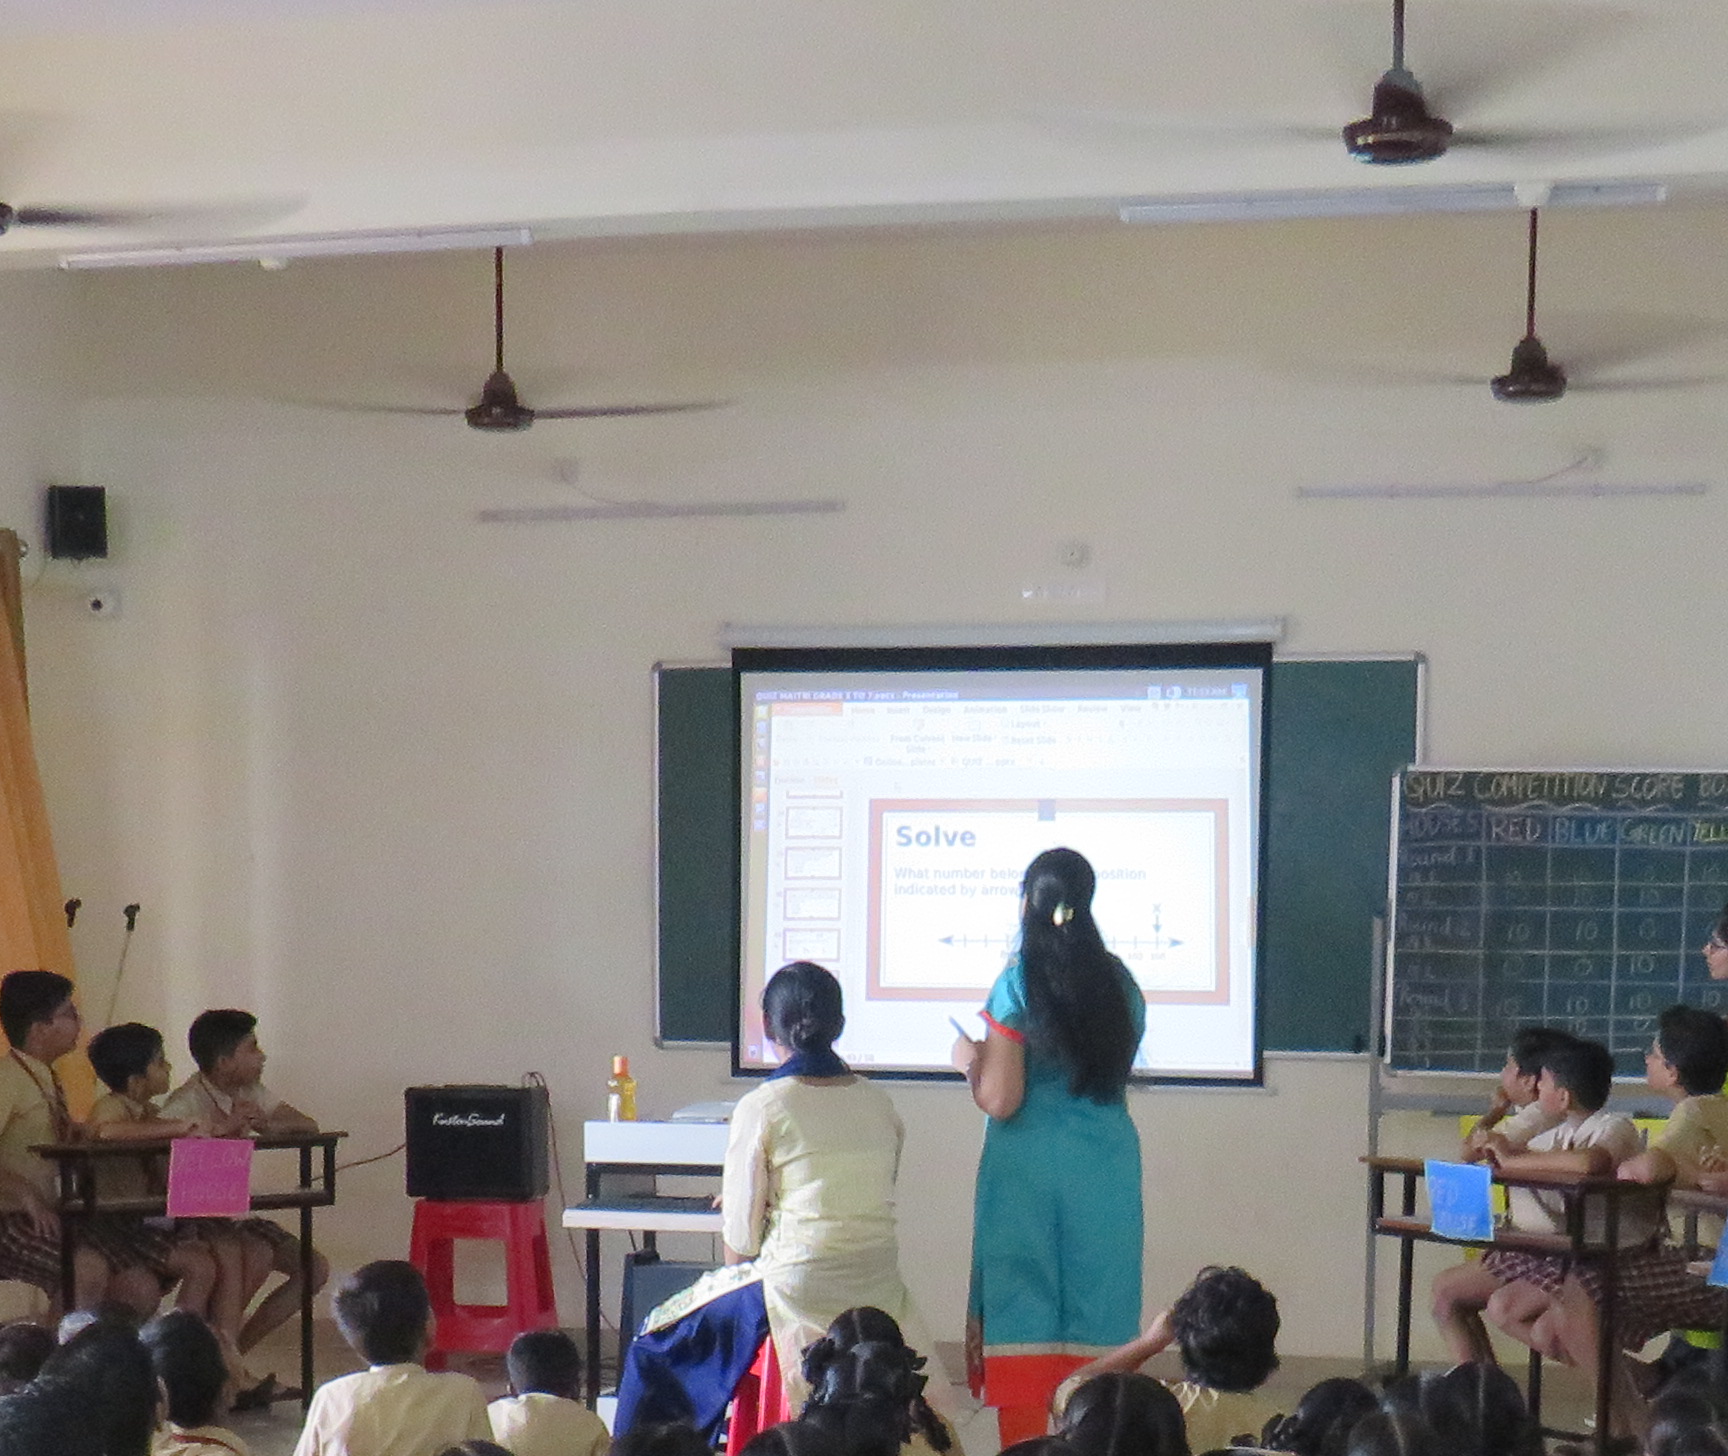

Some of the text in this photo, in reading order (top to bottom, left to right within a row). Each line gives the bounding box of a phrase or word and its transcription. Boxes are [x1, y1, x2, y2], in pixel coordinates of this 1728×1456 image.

[1404, 772, 1466, 802] QUIZ
[1473, 772, 1608, 799] COMPETITION
[1611, 773, 1684, 800] SCORE
[896, 824, 977, 847] Solve
[1490, 817, 1542, 843] RED
[1554, 816, 1610, 844] BLUE
[1620, 818, 1685, 845] GREEN
[894, 866, 929, 880] What
[933, 866, 986, 880] number
[894, 883, 956, 896] indicated
[960, 883, 978, 898] by
